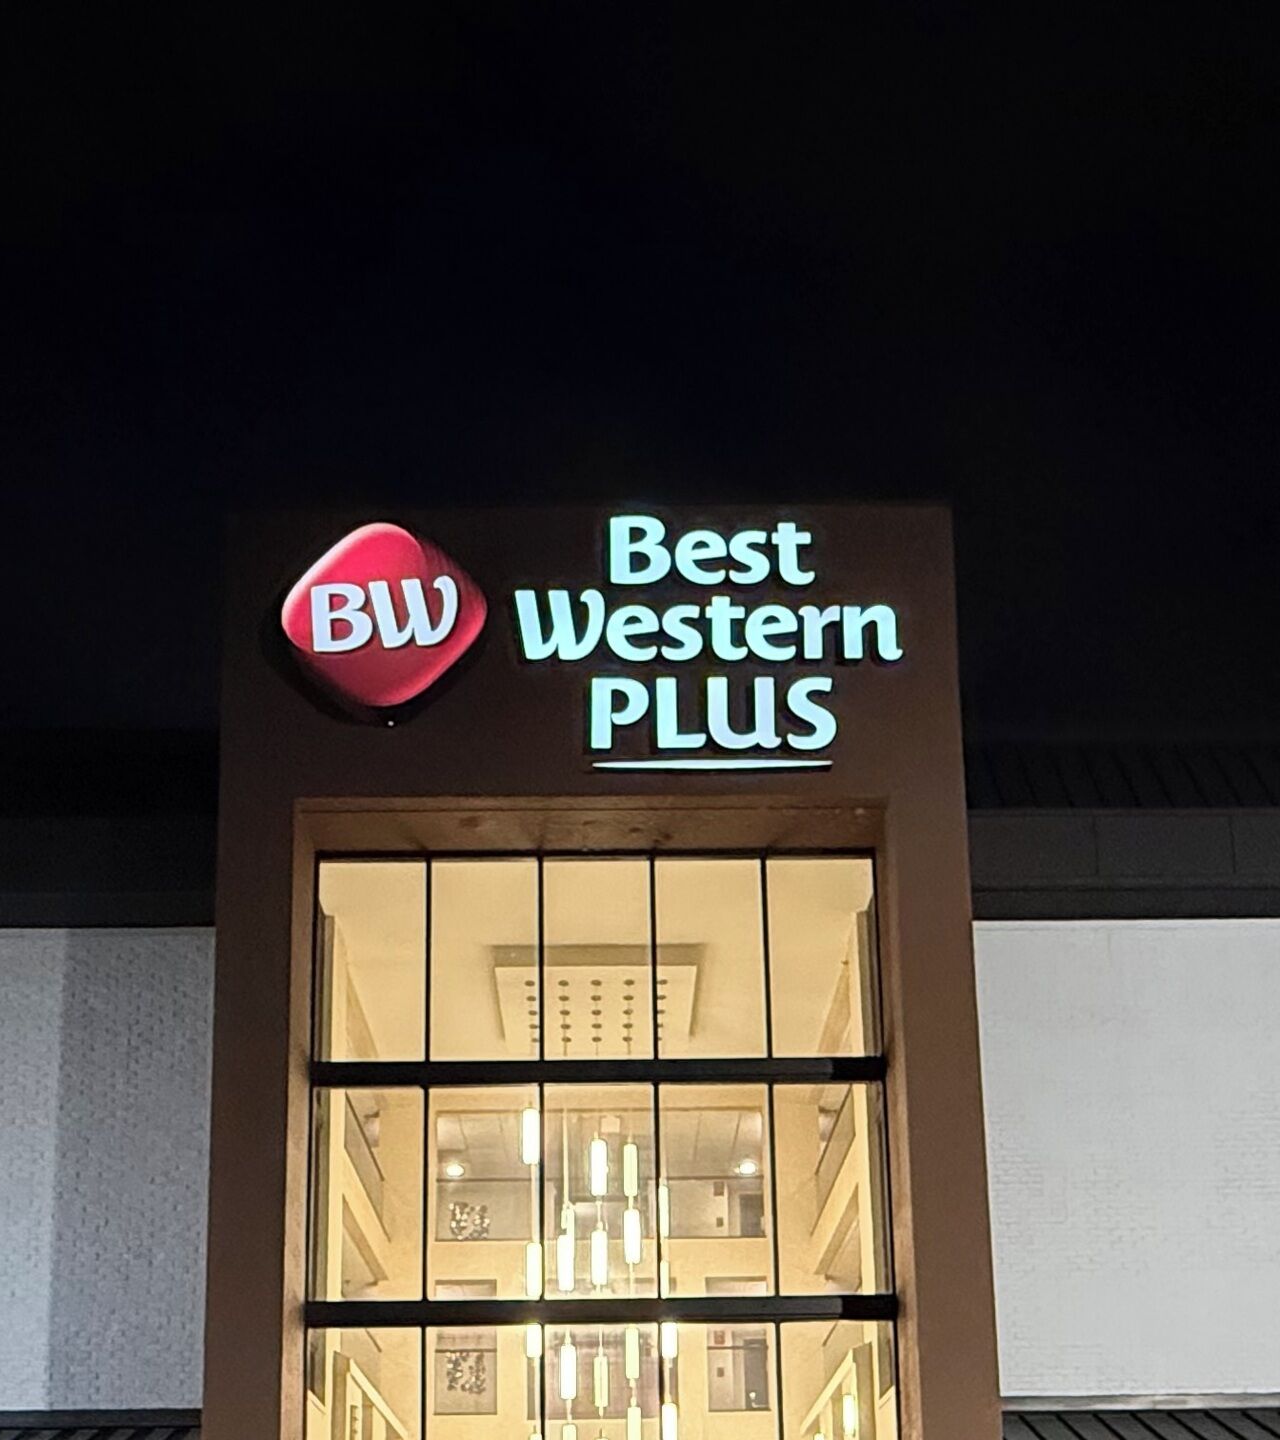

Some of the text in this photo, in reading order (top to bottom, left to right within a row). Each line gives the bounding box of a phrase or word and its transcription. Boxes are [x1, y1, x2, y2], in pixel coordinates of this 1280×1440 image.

[610, 515, 816, 586] Best
[310, 575, 458, 653] BW
[515, 589, 904, 662] Western
[590, 676, 838, 750] PLUS
